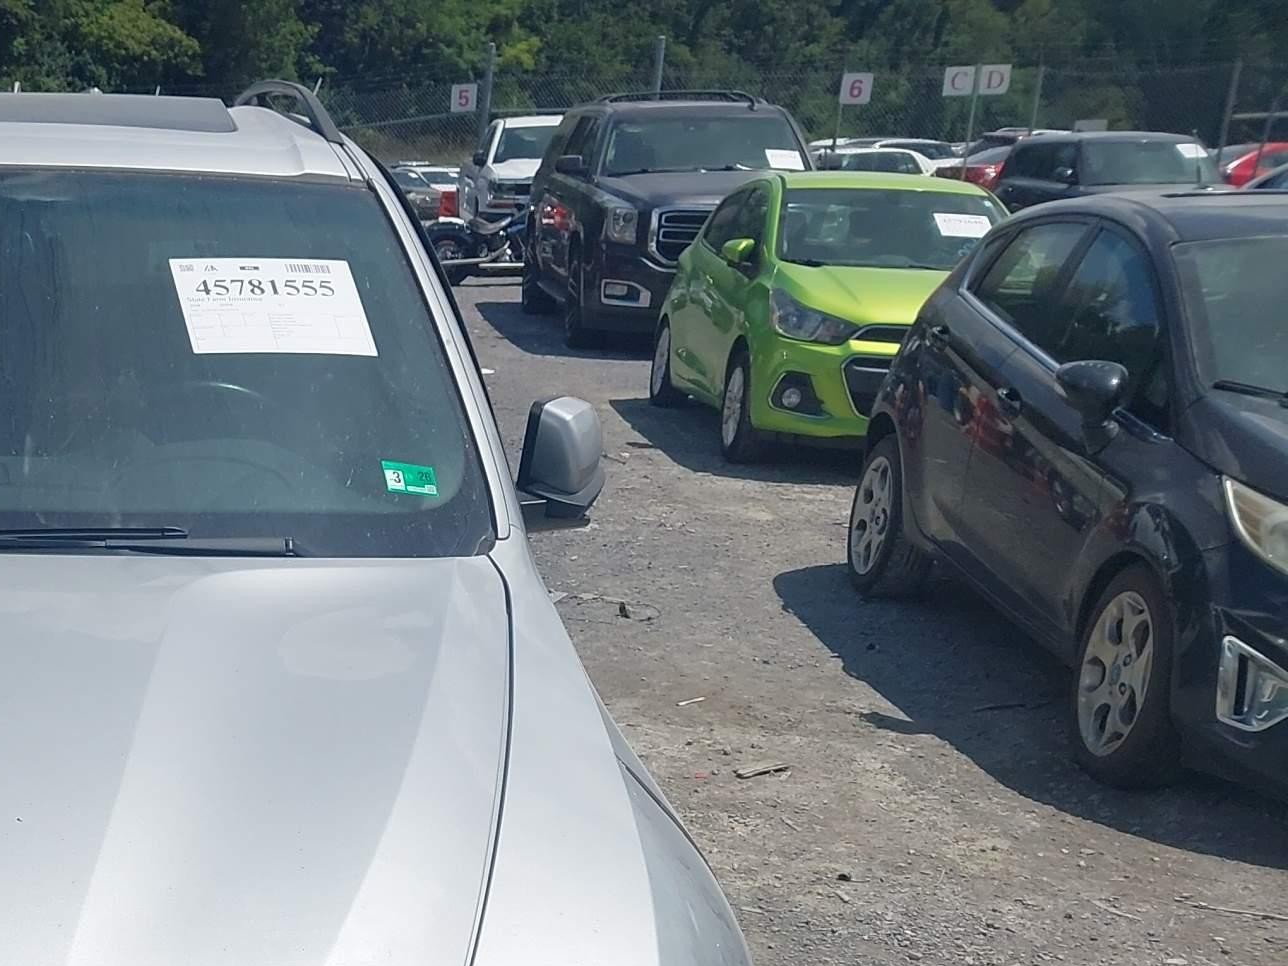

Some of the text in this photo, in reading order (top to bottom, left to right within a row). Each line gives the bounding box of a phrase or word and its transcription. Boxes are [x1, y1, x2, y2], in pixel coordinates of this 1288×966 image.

[848, 79, 863, 98] 6
[951, 71, 968, 90] C
[986, 70, 1005, 89] D
[458, 89, 469, 107] 5
[195, 278, 336, 297] 45781555
[392, 471, 401, 484] 3
